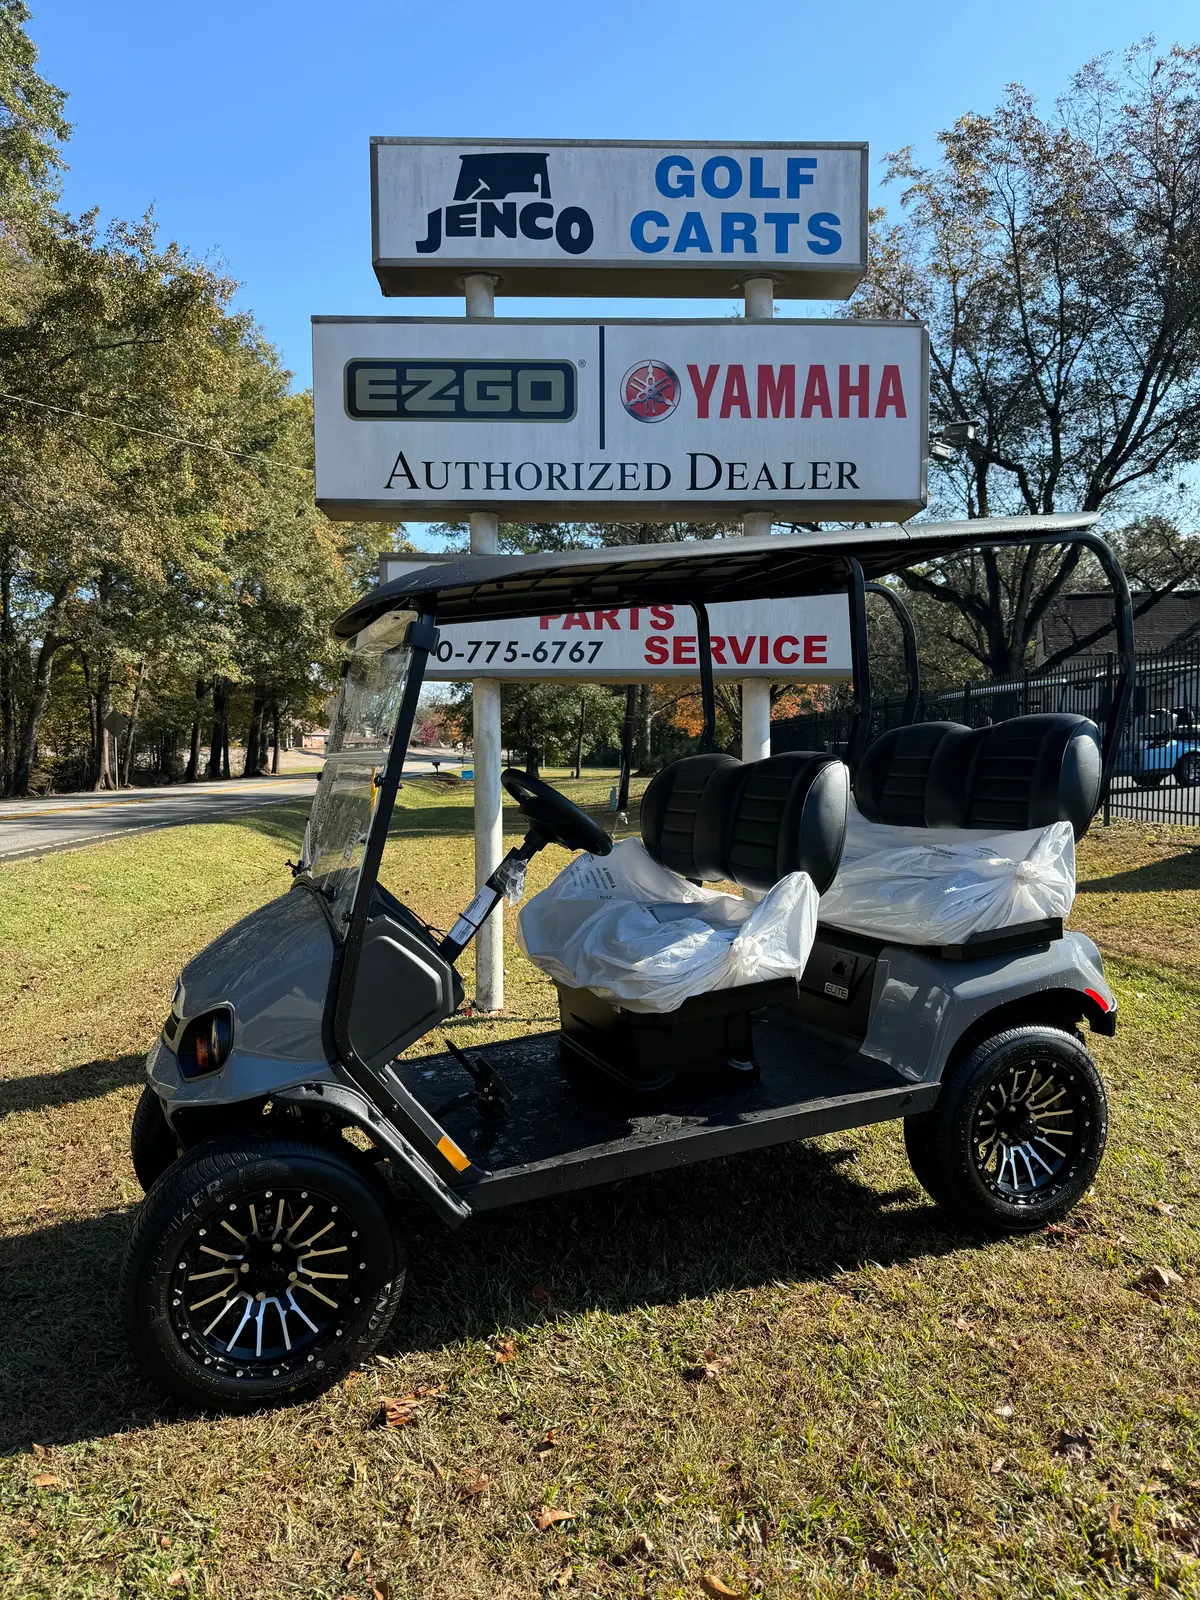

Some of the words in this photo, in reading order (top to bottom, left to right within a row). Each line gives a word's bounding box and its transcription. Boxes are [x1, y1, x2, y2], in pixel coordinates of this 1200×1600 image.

[655, 155, 818, 199] GOLF
[416, 202, 594, 254] JENCO
[630, 211, 843, 255] CARTS
[355, 368, 566, 413] EZGO
[687, 364, 907, 419] YAMAHA
[383, 451, 672, 490] AUTHORIZED
[685, 452, 860, 491] DEALER
[436, 640, 604, 664] 0-775-6767
[644, 635, 828, 665] SERVICE
[825, 983, 848, 999] ELITE
